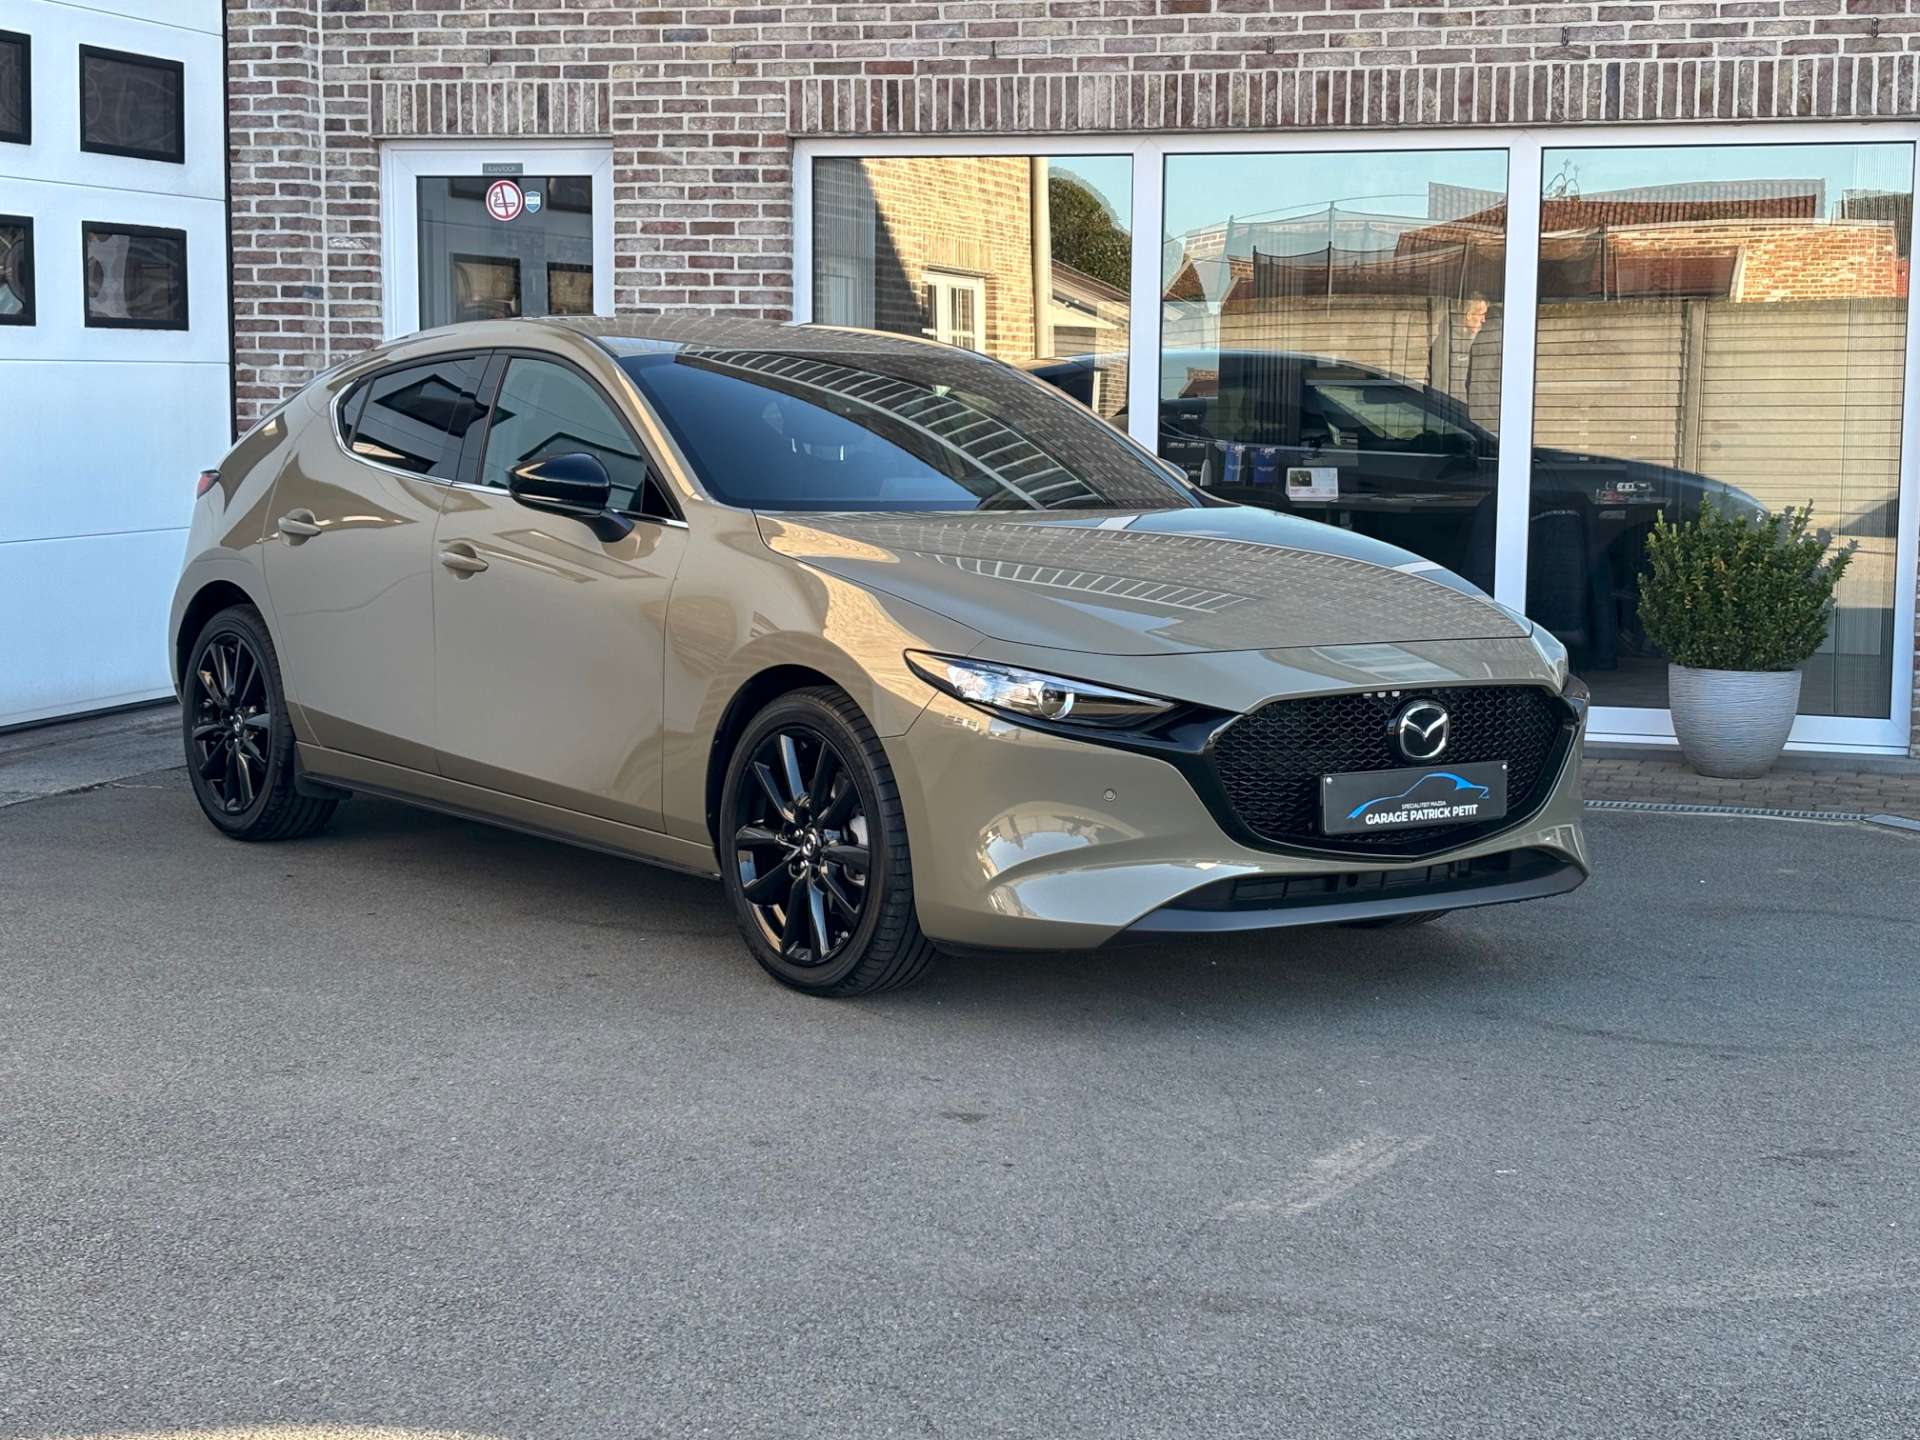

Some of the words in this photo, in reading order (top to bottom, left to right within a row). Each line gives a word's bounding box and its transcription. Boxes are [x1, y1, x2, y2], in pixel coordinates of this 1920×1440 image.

[1365, 811, 1408, 825] GARAGE
[1410, 807, 1451, 821] PATRICK
[1452, 804, 1478, 817] PETIT
